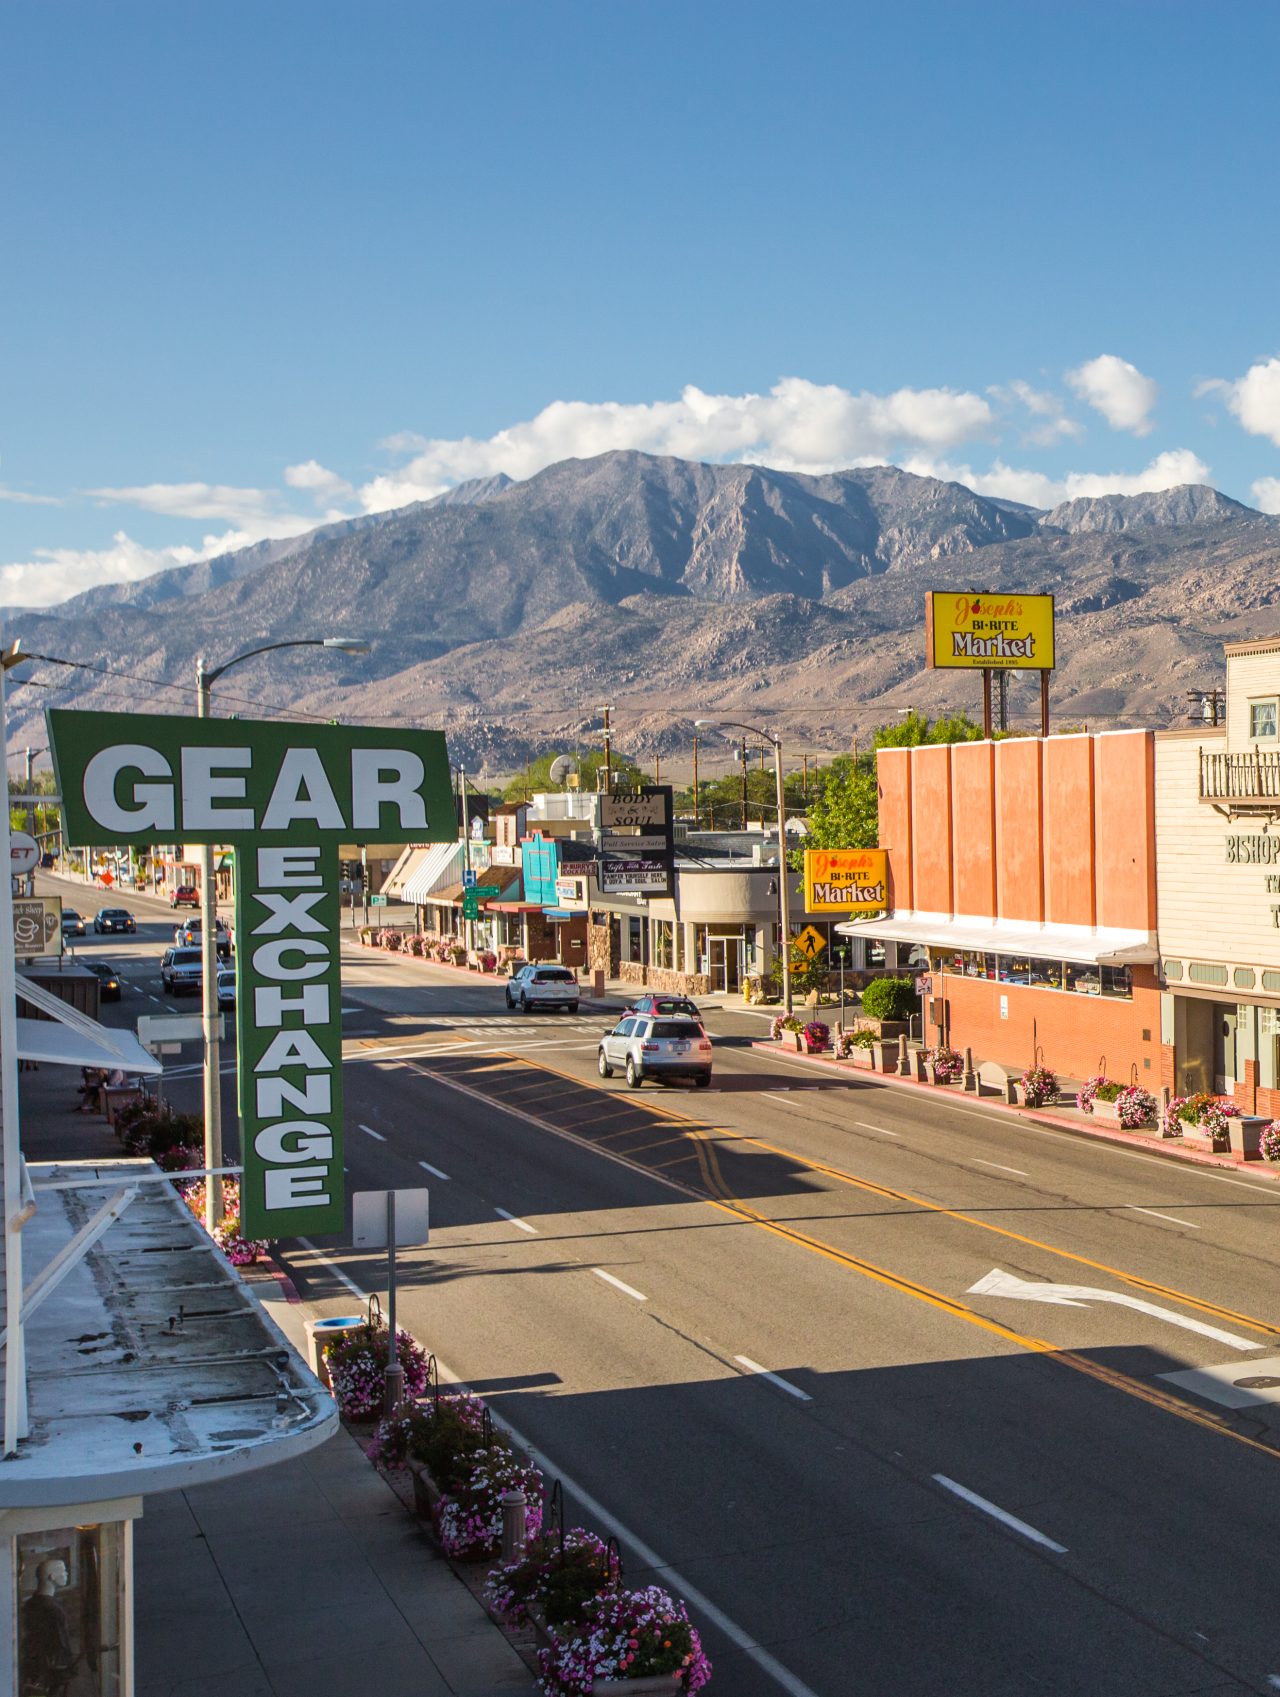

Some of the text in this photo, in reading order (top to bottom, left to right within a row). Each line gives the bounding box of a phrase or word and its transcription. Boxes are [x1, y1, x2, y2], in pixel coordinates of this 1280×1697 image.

[951, 630, 1036, 658] Market
[82, 743, 430, 833] GEAR
[612, 794, 654, 804] BODY
[627, 805, 639, 815] &
[613, 816, 654, 825] SOUL
[11, 847, 34, 858] ET
[464, 870, 475, 883] H
[813, 880, 885, 904] Market
[249, 846, 334, 1211] EXCHANGE
